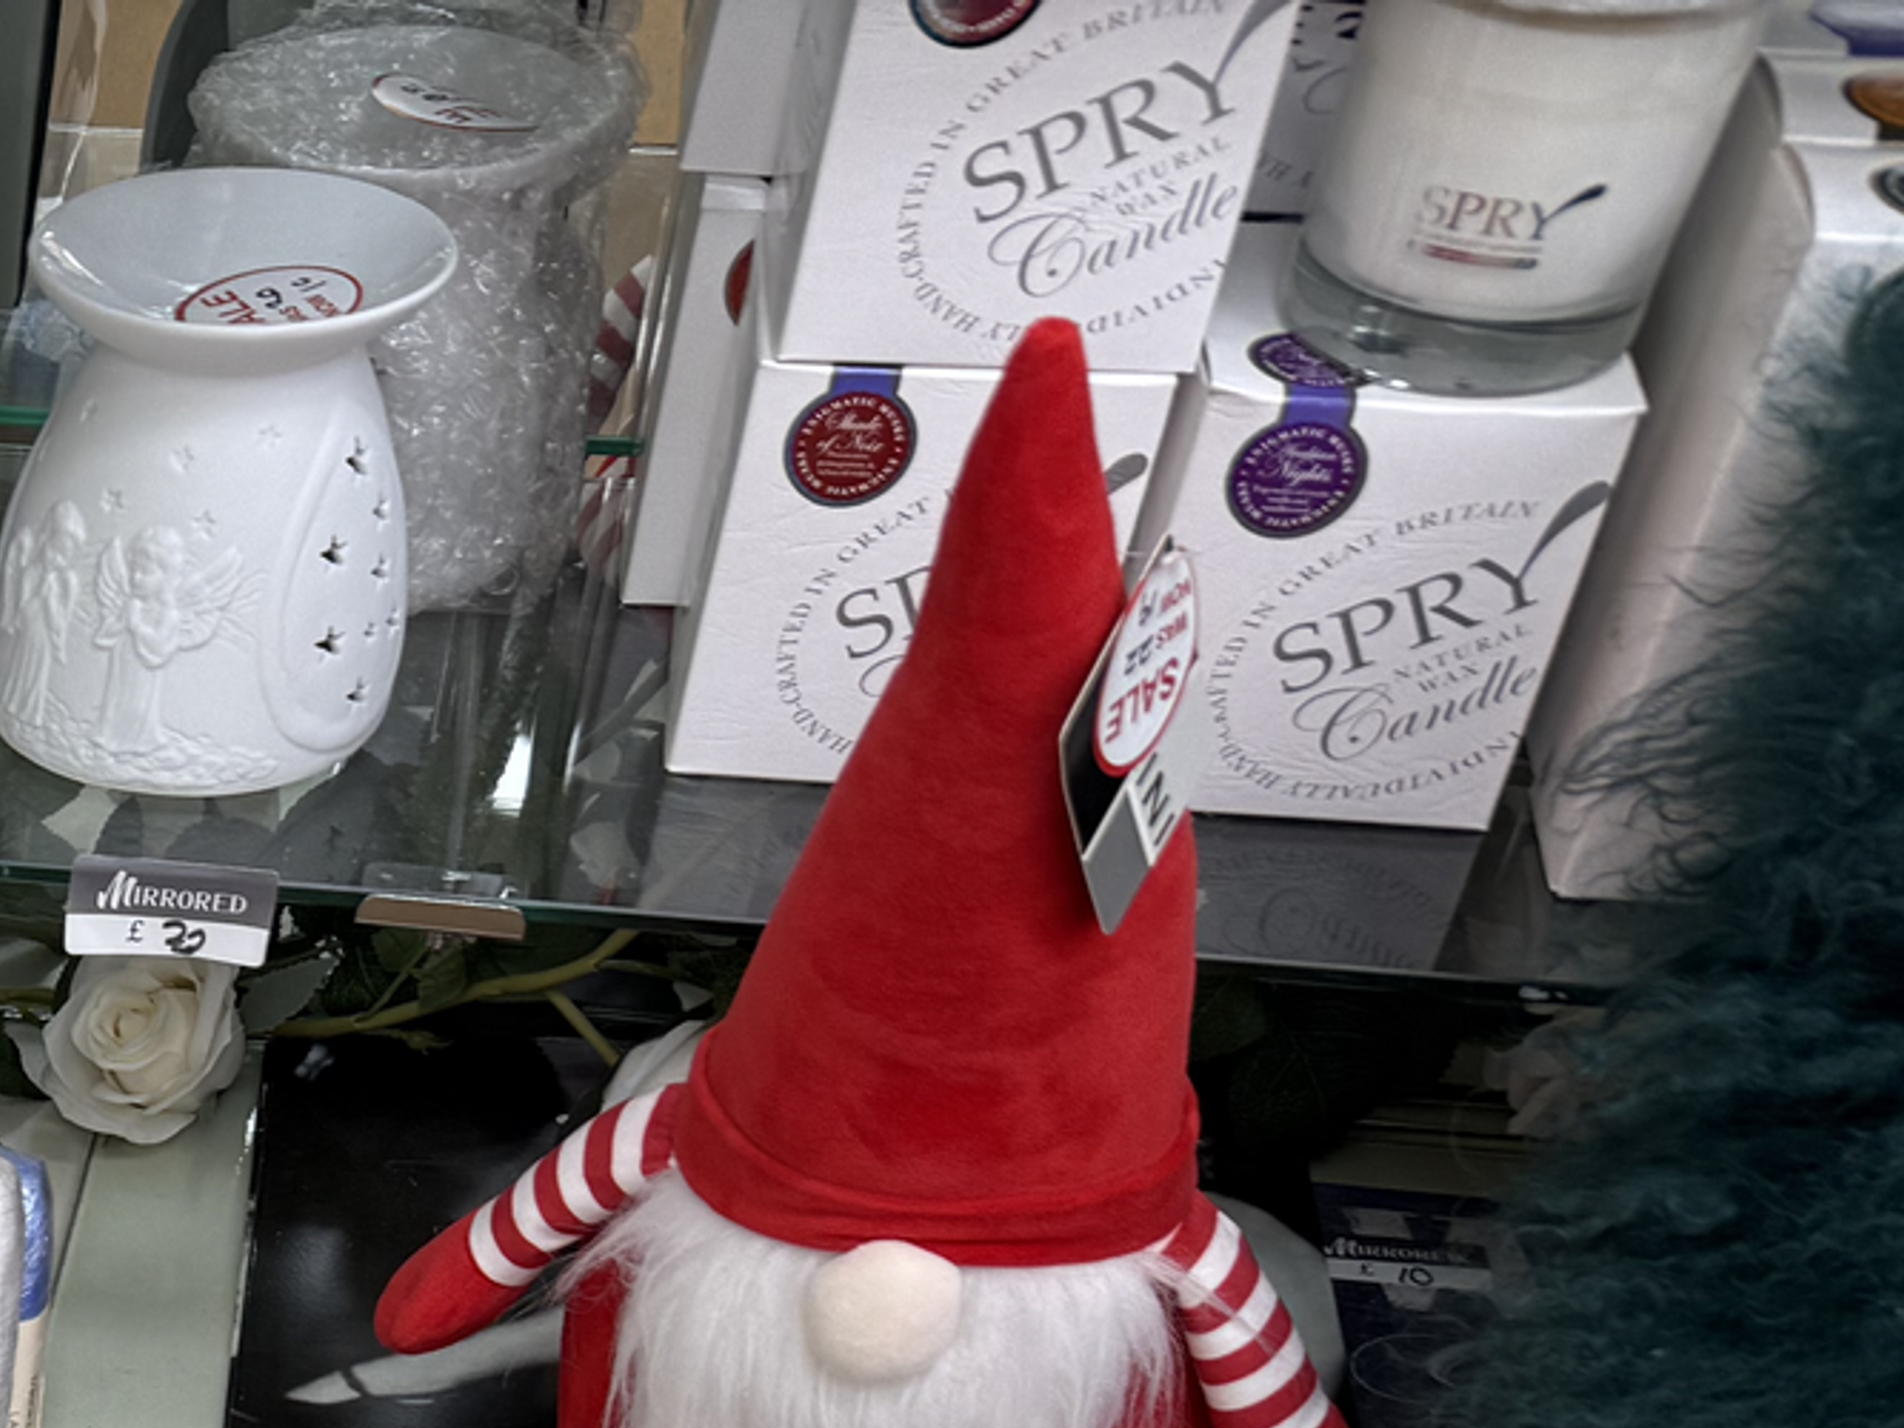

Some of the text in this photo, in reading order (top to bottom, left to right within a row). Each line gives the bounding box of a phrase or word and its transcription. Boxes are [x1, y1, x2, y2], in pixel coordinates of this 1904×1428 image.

[930, 120, 966, 151] IN
[965, 34, 1070, 114] GREAT
[963, 25, 1262, 225] SPRY
[987, 172, 1238, 299] Candle
[1415, 185, 1577, 241] SPRY
[200, 290, 266, 324] ALE
[804, 568, 839, 597] IN
[836, 496, 932, 565] GREAT
[1242, 600, 1277, 629] IN
[1278, 529, 1383, 596] GREAT
[1395, 499, 1539, 537] BRITAIN
[1273, 520, 1572, 694] SPRY
[1104, 657, 1180, 745] SALE
[1292, 654, 1537, 762] Candle
[96, 869, 247, 915] MIRRORED
[126, 919, 145, 943] £
